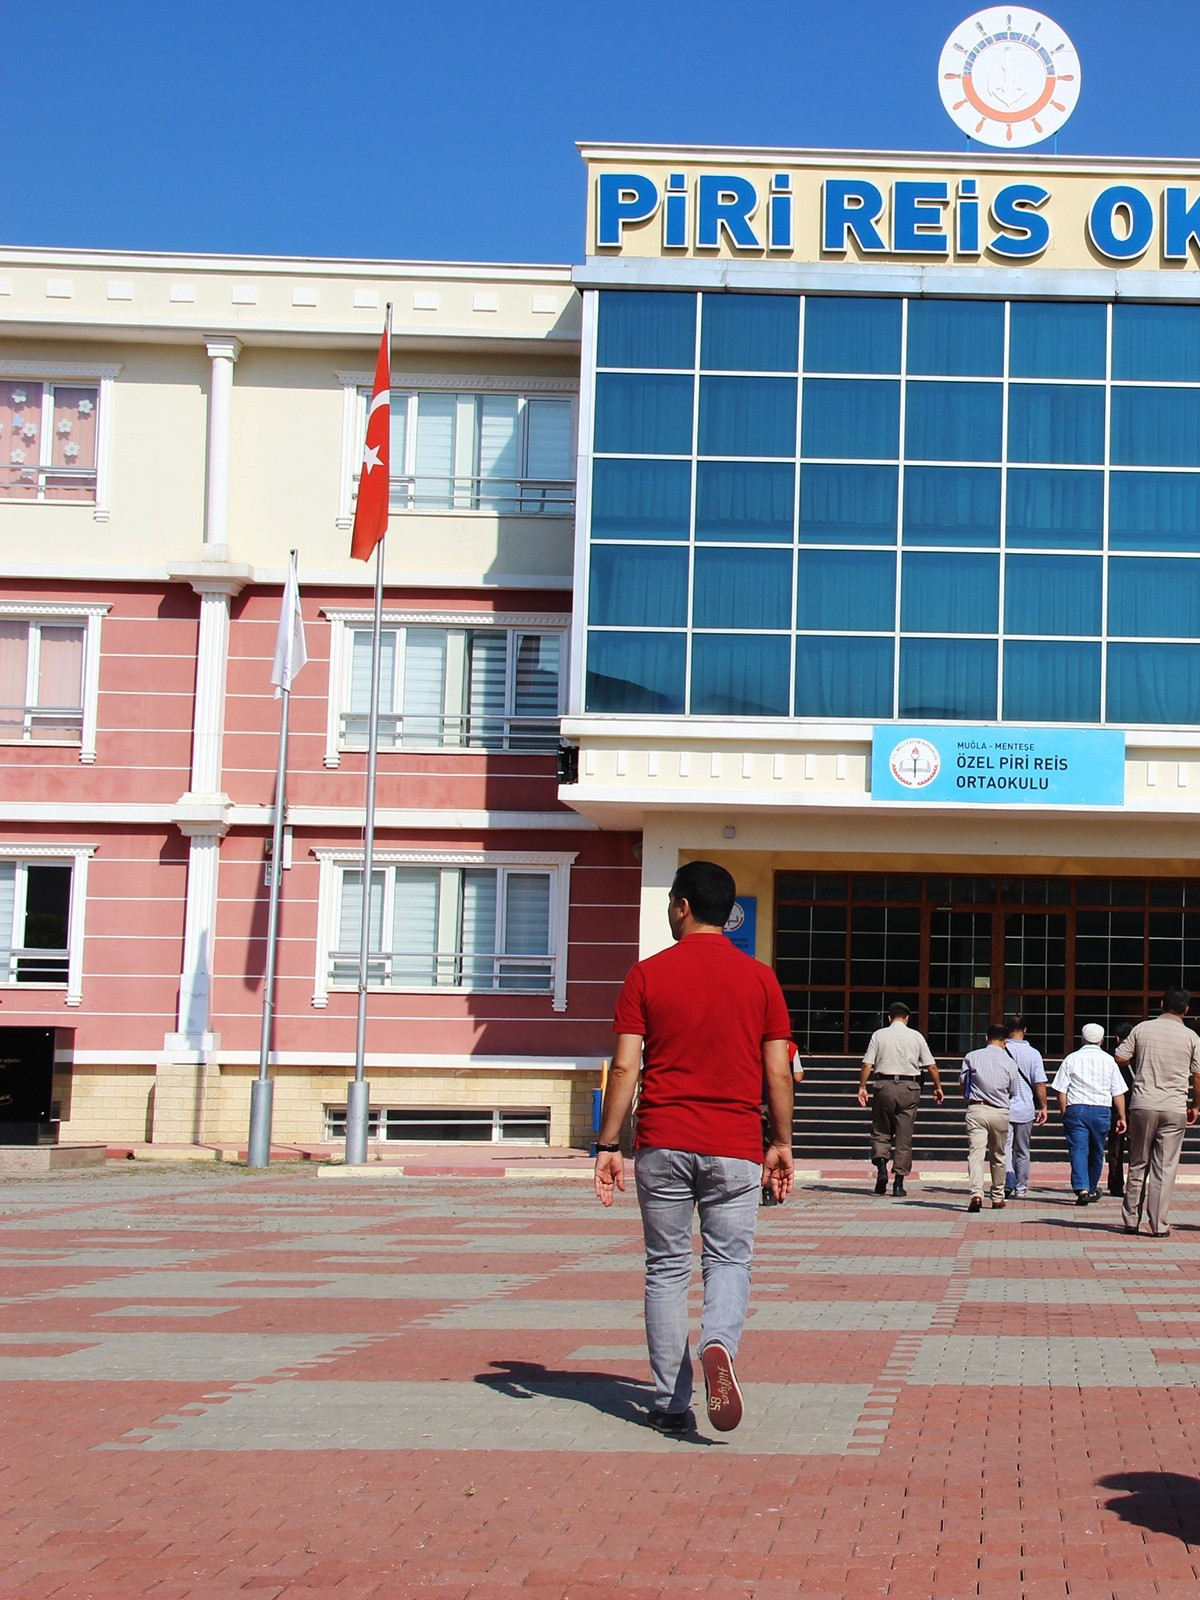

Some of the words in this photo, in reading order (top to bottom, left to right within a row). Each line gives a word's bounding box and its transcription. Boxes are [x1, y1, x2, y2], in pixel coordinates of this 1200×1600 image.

[957, 740, 987, 750] MUĞLA
[994, 742, 1035, 751] MENTEŞE
[957, 752, 995, 769] ÖZEL
[999, 753, 1029, 770] PİRİ
[1034, 755, 1069, 771] REİS
[956, 775, 1049, 790] ORTAOKULU
[717, 1365, 732, 1406] Hilfiger
[710, 1396, 721, 1411] 85
